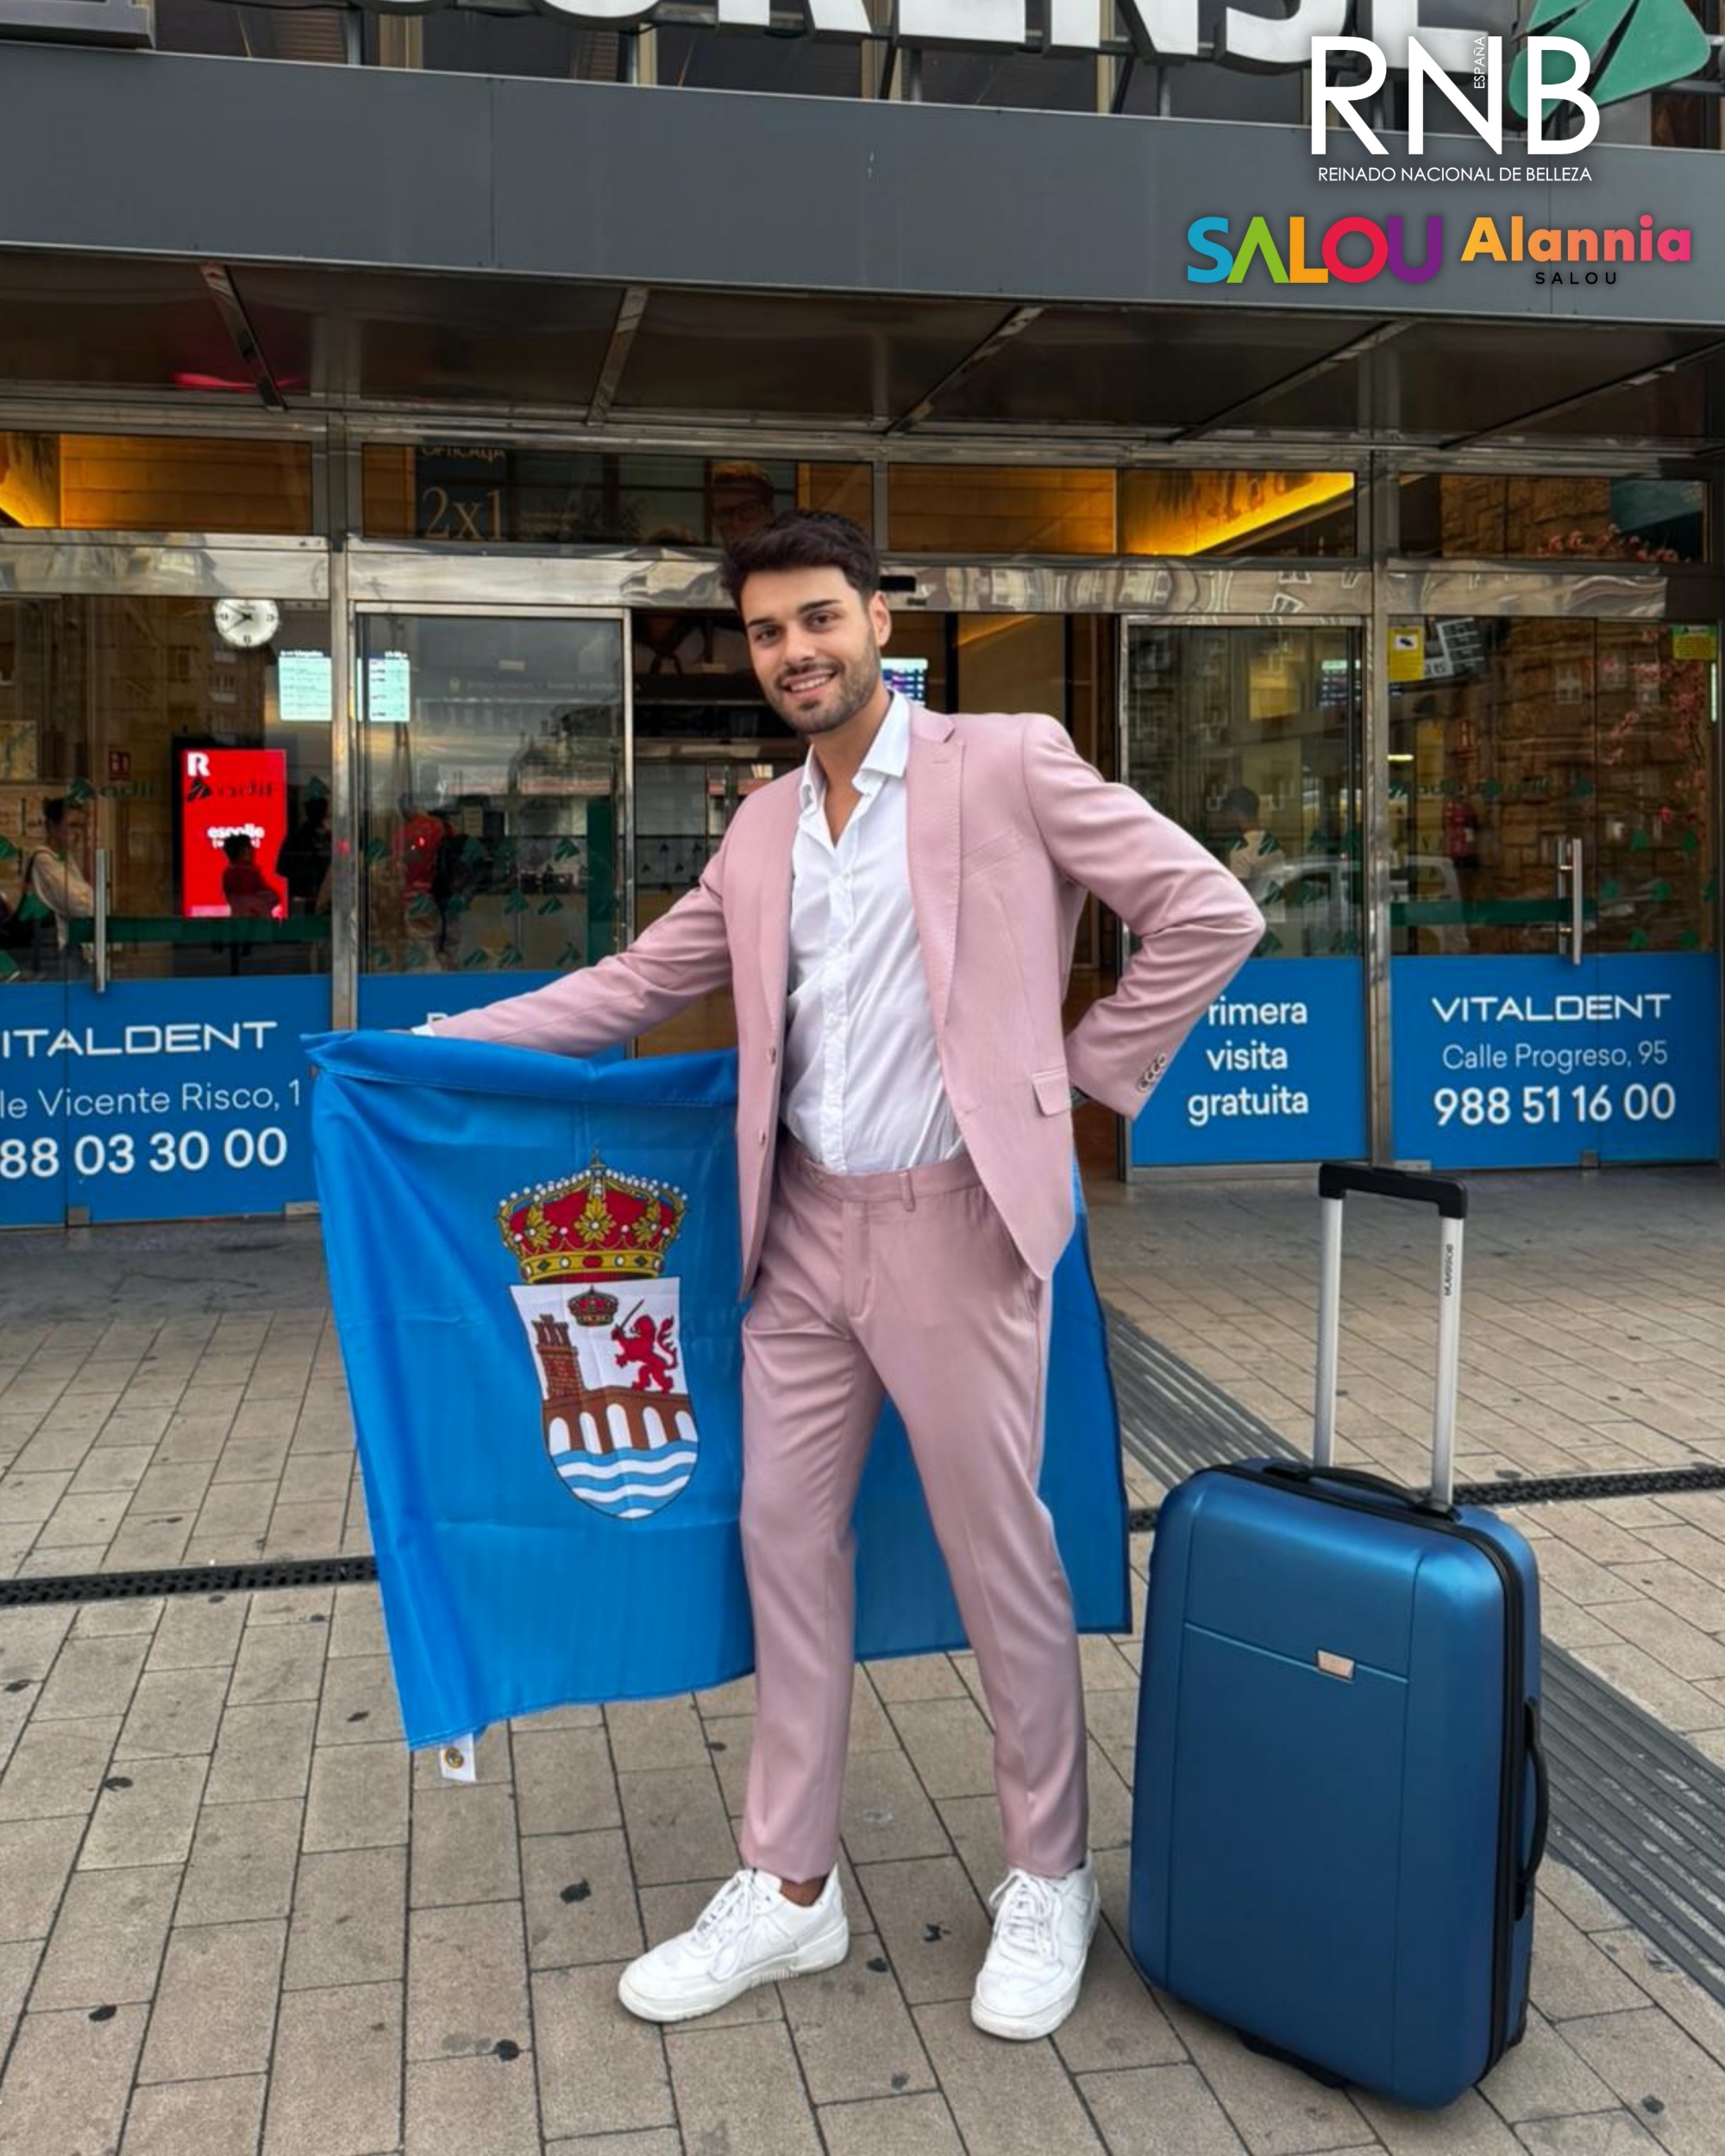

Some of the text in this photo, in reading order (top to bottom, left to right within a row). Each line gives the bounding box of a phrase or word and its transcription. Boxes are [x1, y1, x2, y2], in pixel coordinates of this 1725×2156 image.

[423, 486, 503, 540] 2x1
[1208, 994, 1308, 1026] rimera
[1431, 994, 1672, 1023] VITALDENT
[2, 1021, 278, 1059] ITALDENT
[1206, 1039, 1289, 1071] visita
[1442, 1039, 1668, 1075] Calle Progreso, 95
[0, 1090, 28, 1119] le
[38, 1086, 170, 1117] Vicente
[181, 1082, 280, 1112] Risco,
[1188, 1083, 1309, 1126] gratuita
[1433, 1082, 1676, 1126] 988 51 16 00
[0, 1127, 287, 1179] 88 03 30 00
